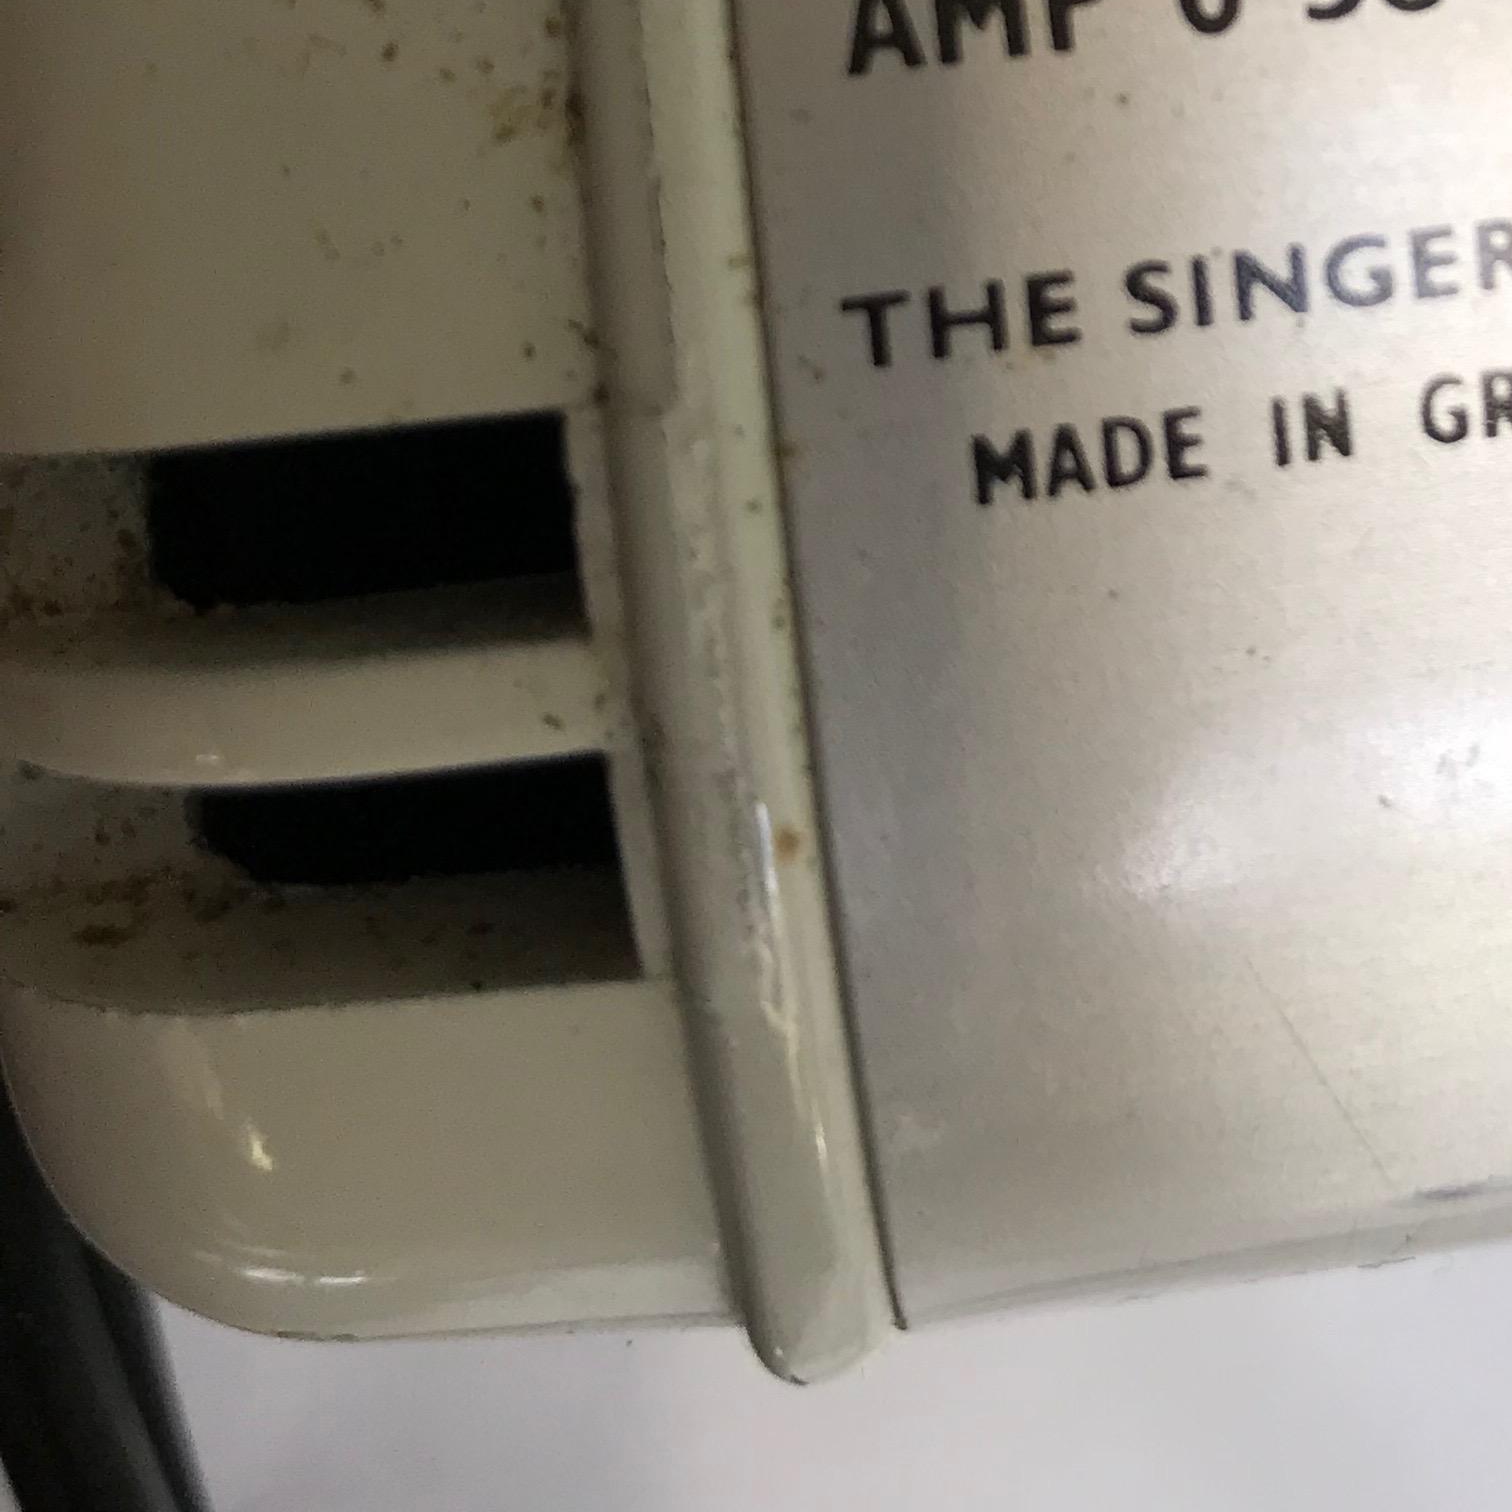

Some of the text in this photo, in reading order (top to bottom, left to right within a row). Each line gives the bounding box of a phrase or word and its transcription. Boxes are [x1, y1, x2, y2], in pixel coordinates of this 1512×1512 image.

[840, 271, 1082, 369] THE
[971, 416, 1210, 506] MADE
[1270, 389, 1355, 469] IN
